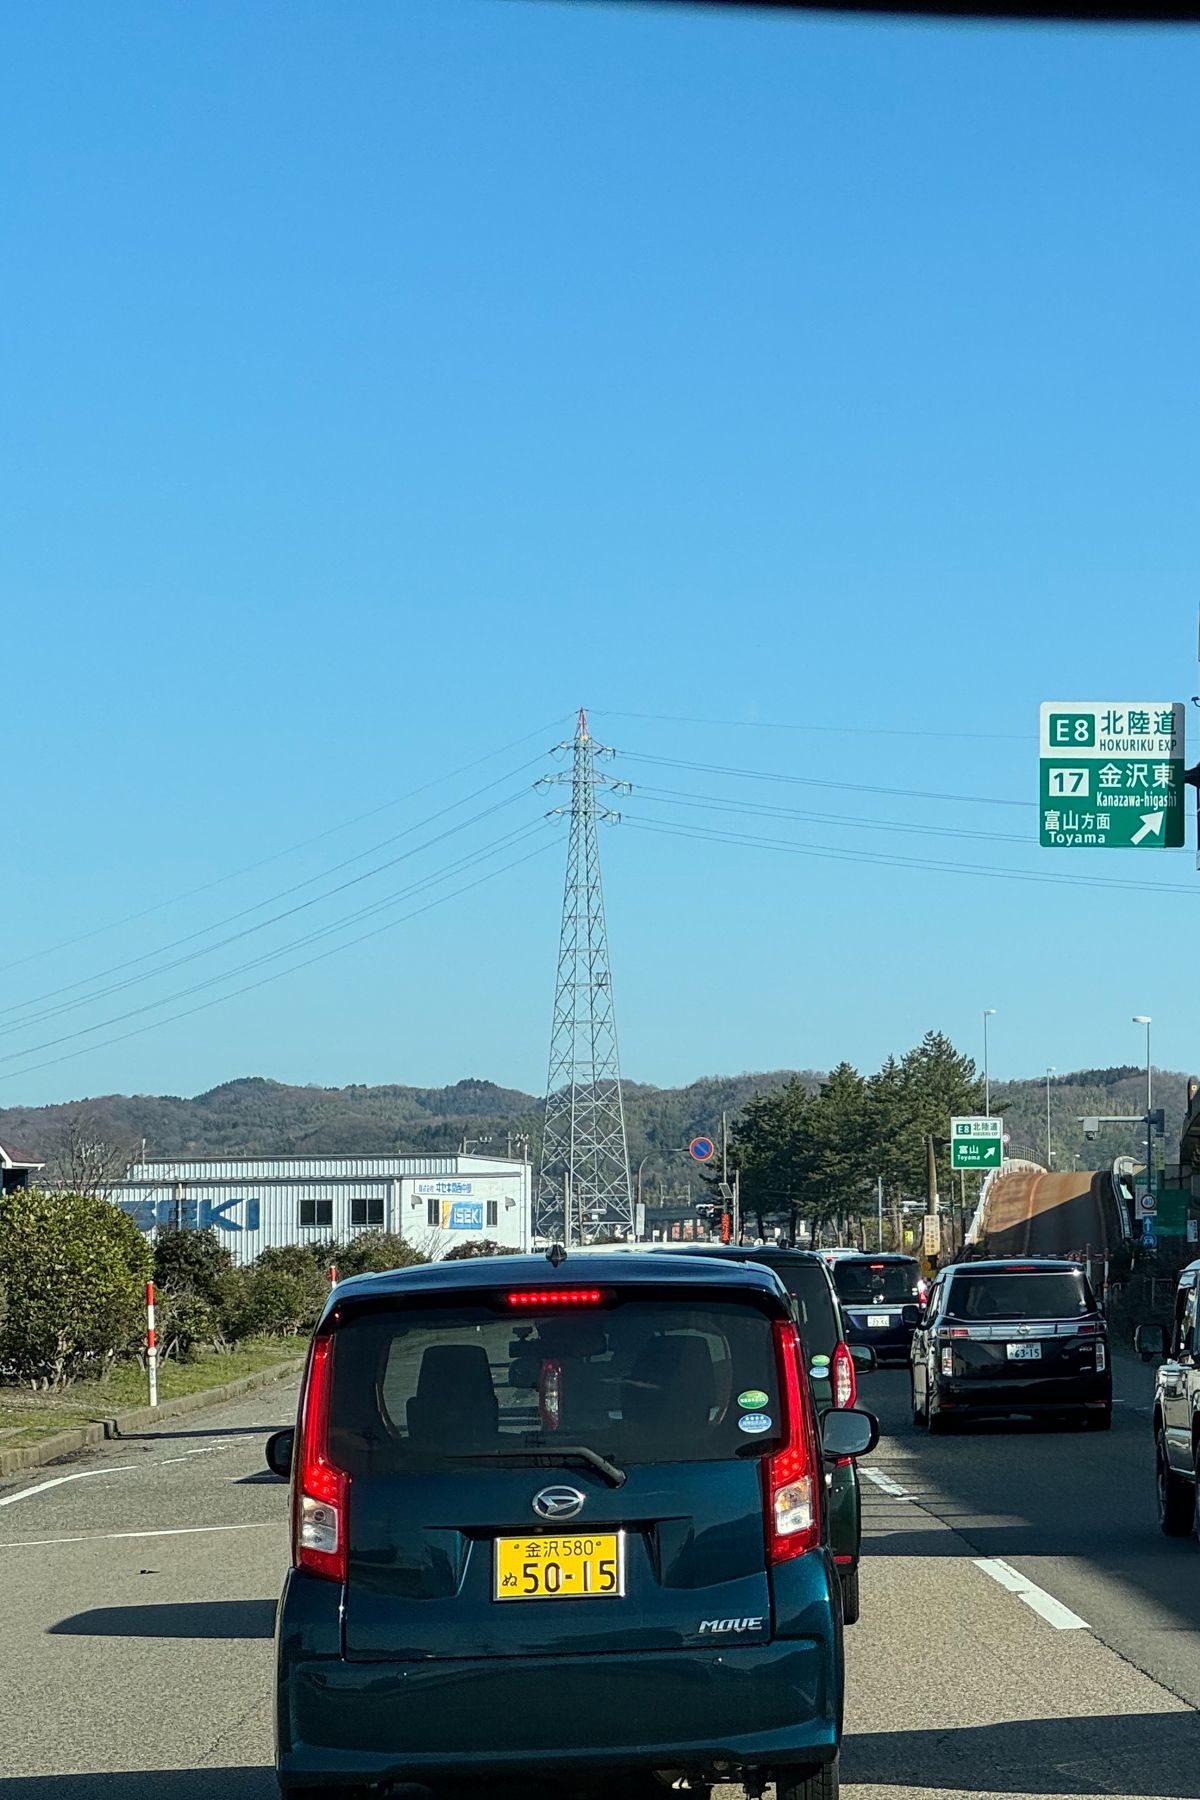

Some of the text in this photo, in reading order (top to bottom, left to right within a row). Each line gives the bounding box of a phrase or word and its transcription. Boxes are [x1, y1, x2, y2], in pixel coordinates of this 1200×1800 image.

[1056, 710, 1177, 742] E8 北陸道
[1100, 739, 1177, 752] HOKURIKU EXP
[1053, 762, 1176, 793] 17 金沢東
[1096, 791, 1177, 810] Kanazawa-higashi
[1044, 810, 1111, 831] 富山方面
[1049, 831, 1106, 846] Toyama
[957, 1122, 998, 1134] E8 北陸道
[959, 1145, 979, 1154] 富山
[118, 1199, 260, 1231] SEKI
[454, 1207, 482, 1224] ISEKI
[502, 1560, 616, 1594] ぬ 50-15
[698, 1616, 763, 1633] MOVE
